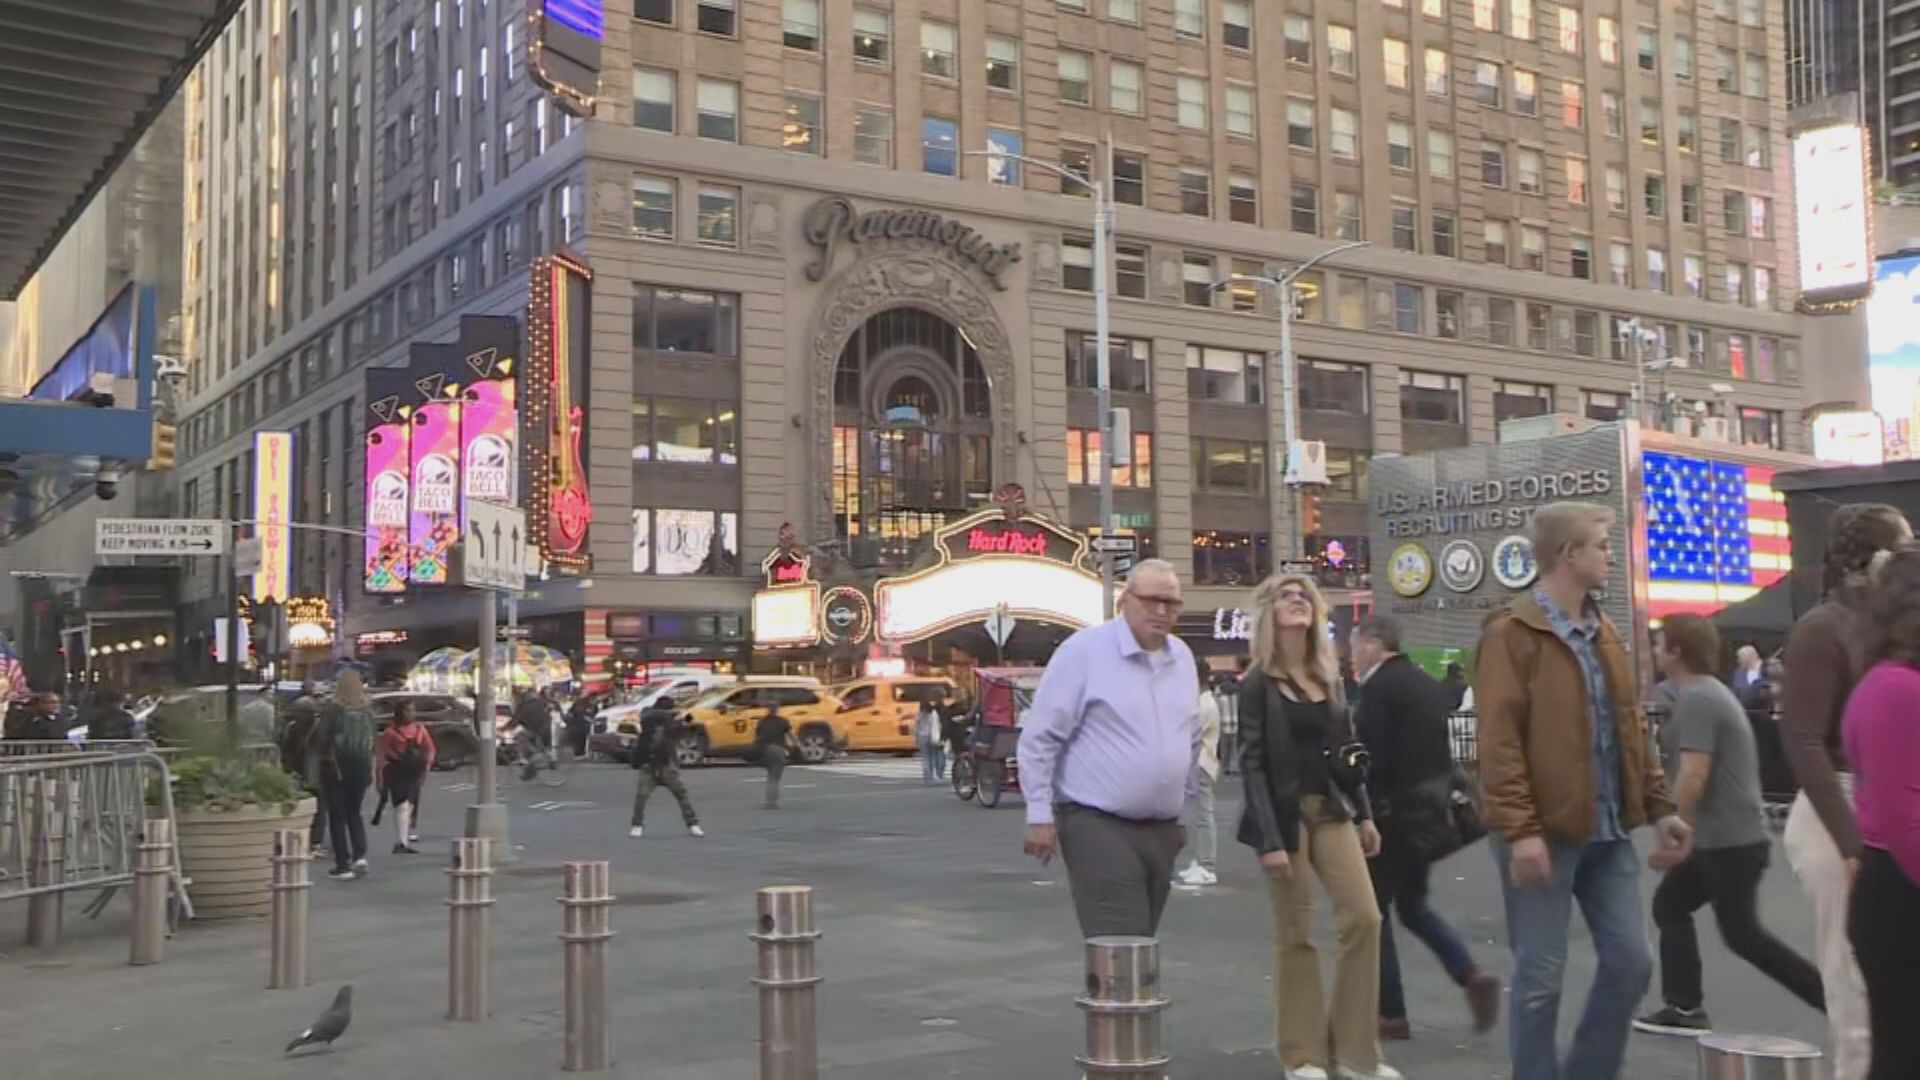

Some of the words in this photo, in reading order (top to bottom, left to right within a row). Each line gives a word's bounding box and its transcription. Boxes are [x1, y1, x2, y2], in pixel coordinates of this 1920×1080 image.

[802, 195, 1022, 291] Paramount
[470, 471, 504, 480] TACO
[418, 485, 450, 497] TACO
[470, 480, 502, 493] BELL
[1416, 480, 1502, 512] ARMED
[1503, 468, 1611, 500] FORCES
[418, 496, 449, 508] BELL
[102, 523, 160, 535] PEDESTRIAN
[1386, 508, 1502, 538] RECRUITING
[102, 537, 125, 549] KEEP
[968, 529, 1008, 551] Hard
[1008, 531, 1048, 557] Rock
